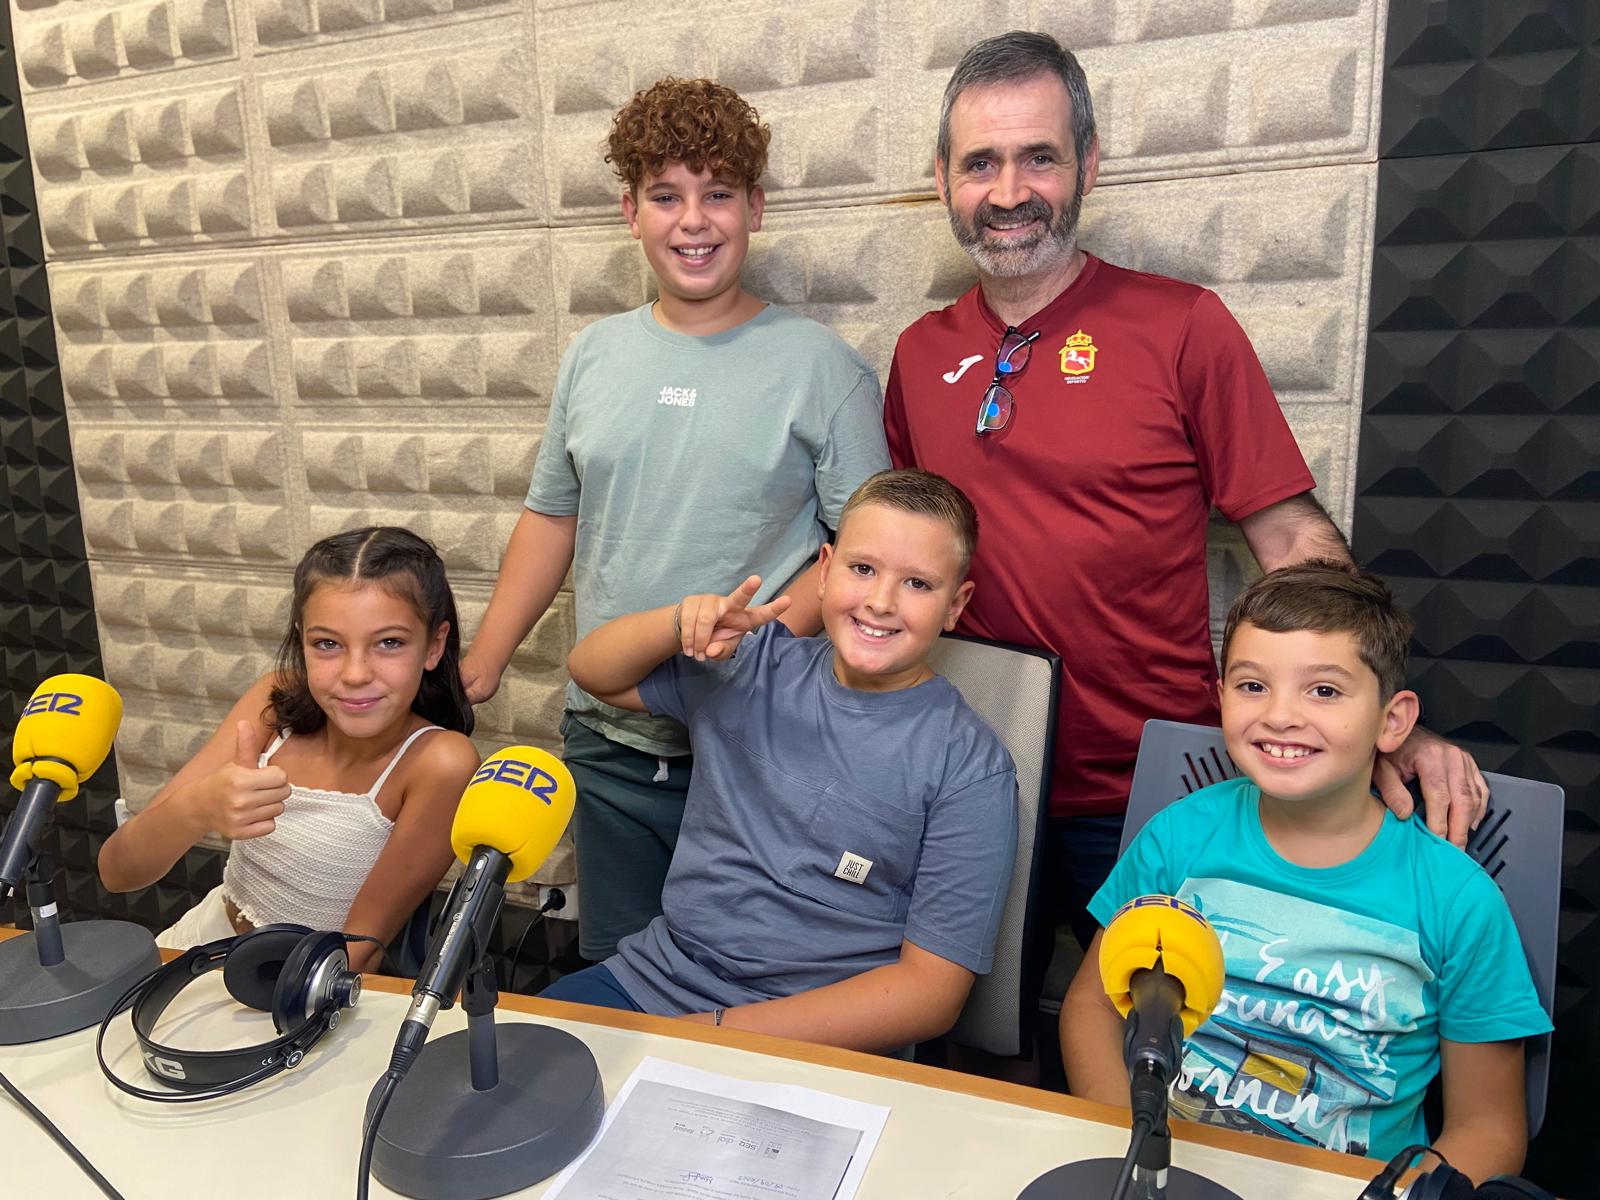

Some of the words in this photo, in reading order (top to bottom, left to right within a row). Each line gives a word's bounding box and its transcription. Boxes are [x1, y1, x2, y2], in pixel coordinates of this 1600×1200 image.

[659, 386, 697, 398] JACK&
[657, 395, 696, 408] JONES
[469, 760, 558, 806] SER
[846, 859, 865, 872] JUST
[842, 867, 860, 879] CHILL
[1255, 937, 1397, 1032] Easy
[1170, 1064, 1352, 1154] orning
